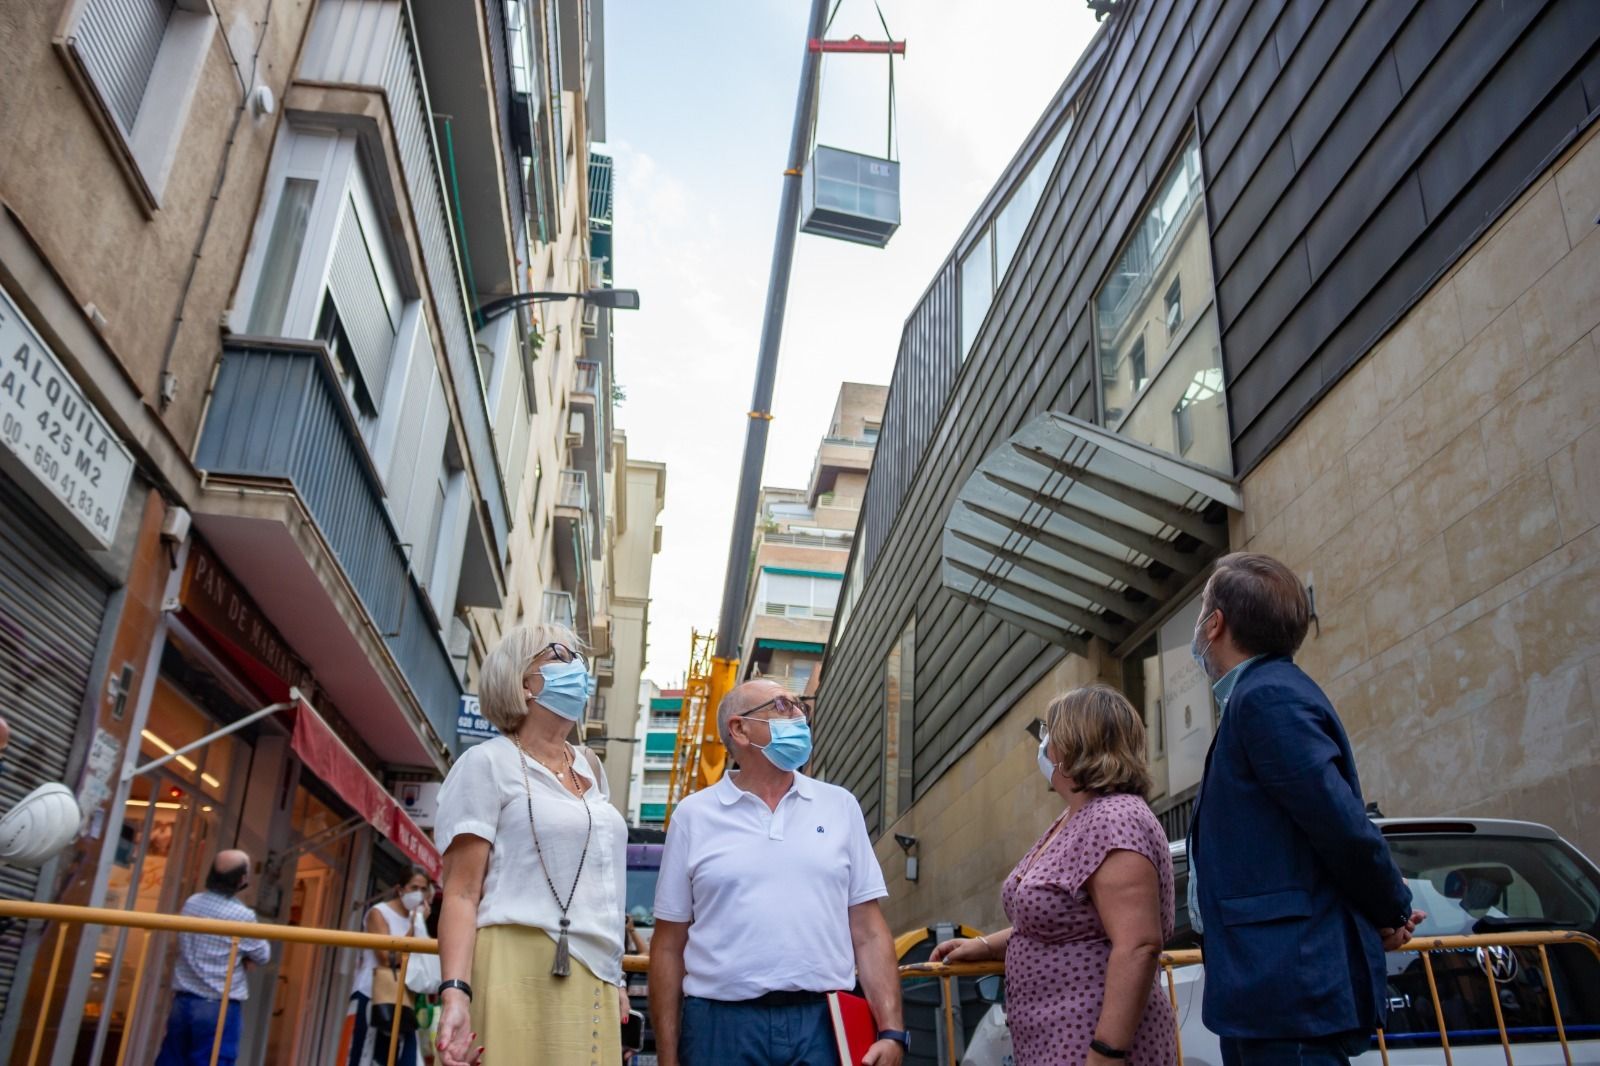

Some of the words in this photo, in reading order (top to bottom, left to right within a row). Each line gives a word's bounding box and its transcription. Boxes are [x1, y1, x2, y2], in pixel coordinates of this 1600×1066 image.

[0, 357, 25, 410] AL
[36, 409, 73, 457] 425
[74, 447, 102, 489] M2
[13, 342, 109, 462] ALQUILA
[33, 443, 59, 482] 650
[60, 473, 76, 506] 41
[78, 489, 94, 517] 83
[94, 506, 110, 533] 64
[194, 554, 226, 606] PAN
[227, 594, 248, 632] DE
